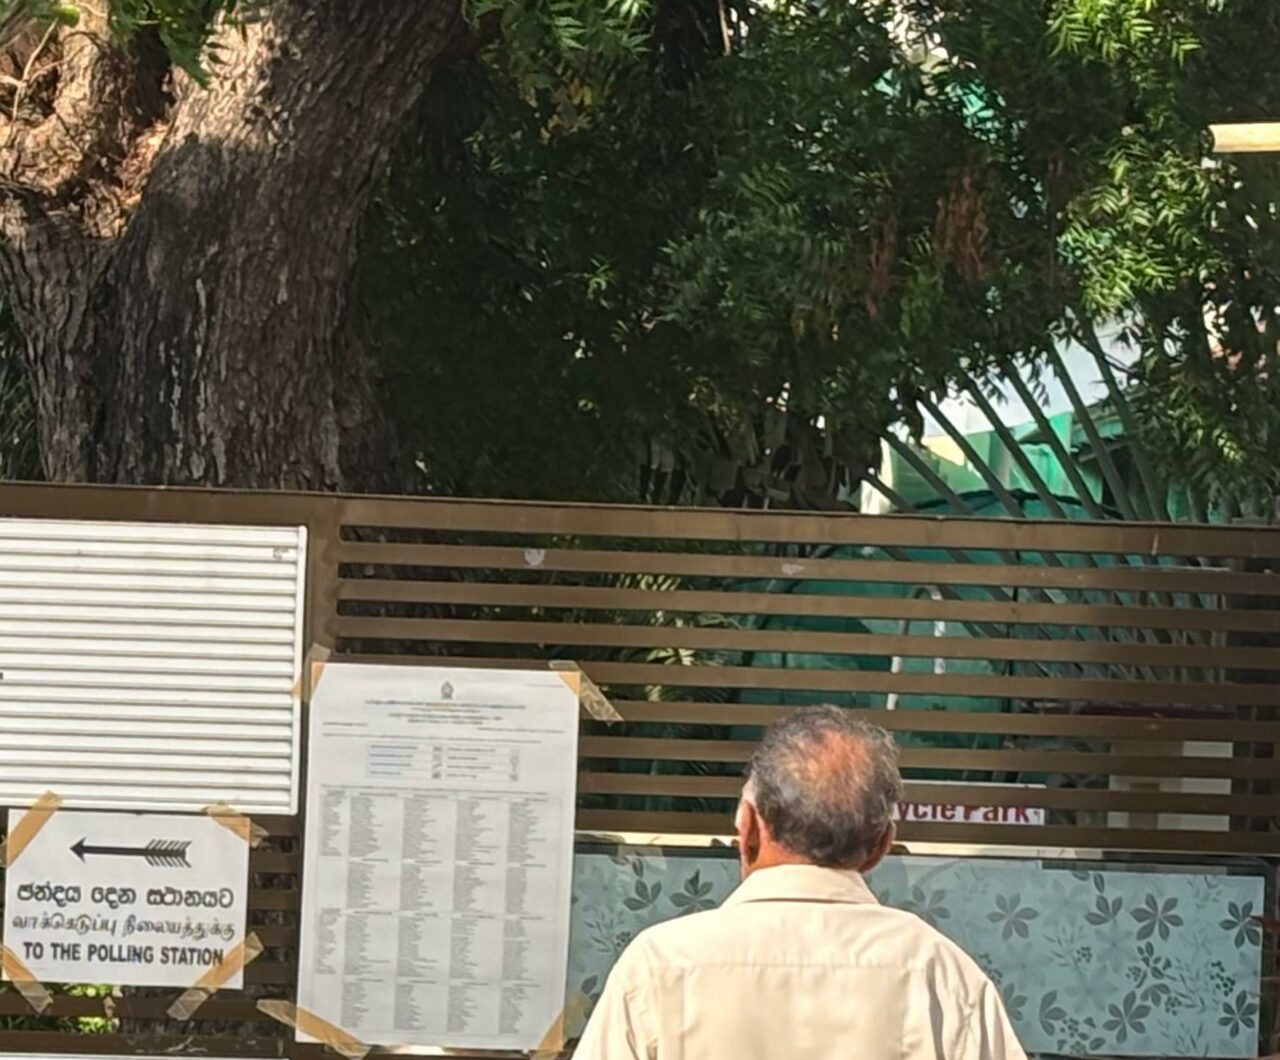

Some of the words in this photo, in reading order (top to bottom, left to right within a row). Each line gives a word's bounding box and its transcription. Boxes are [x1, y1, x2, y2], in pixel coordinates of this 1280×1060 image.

[896, 801, 956, 820] ycle
[91, 886, 137, 909] දෙන
[23, 942, 44, 959] TO
[50, 942, 81, 961] THE
[88, 944, 154, 964] POLLING
[160, 946, 224, 967] STATION
